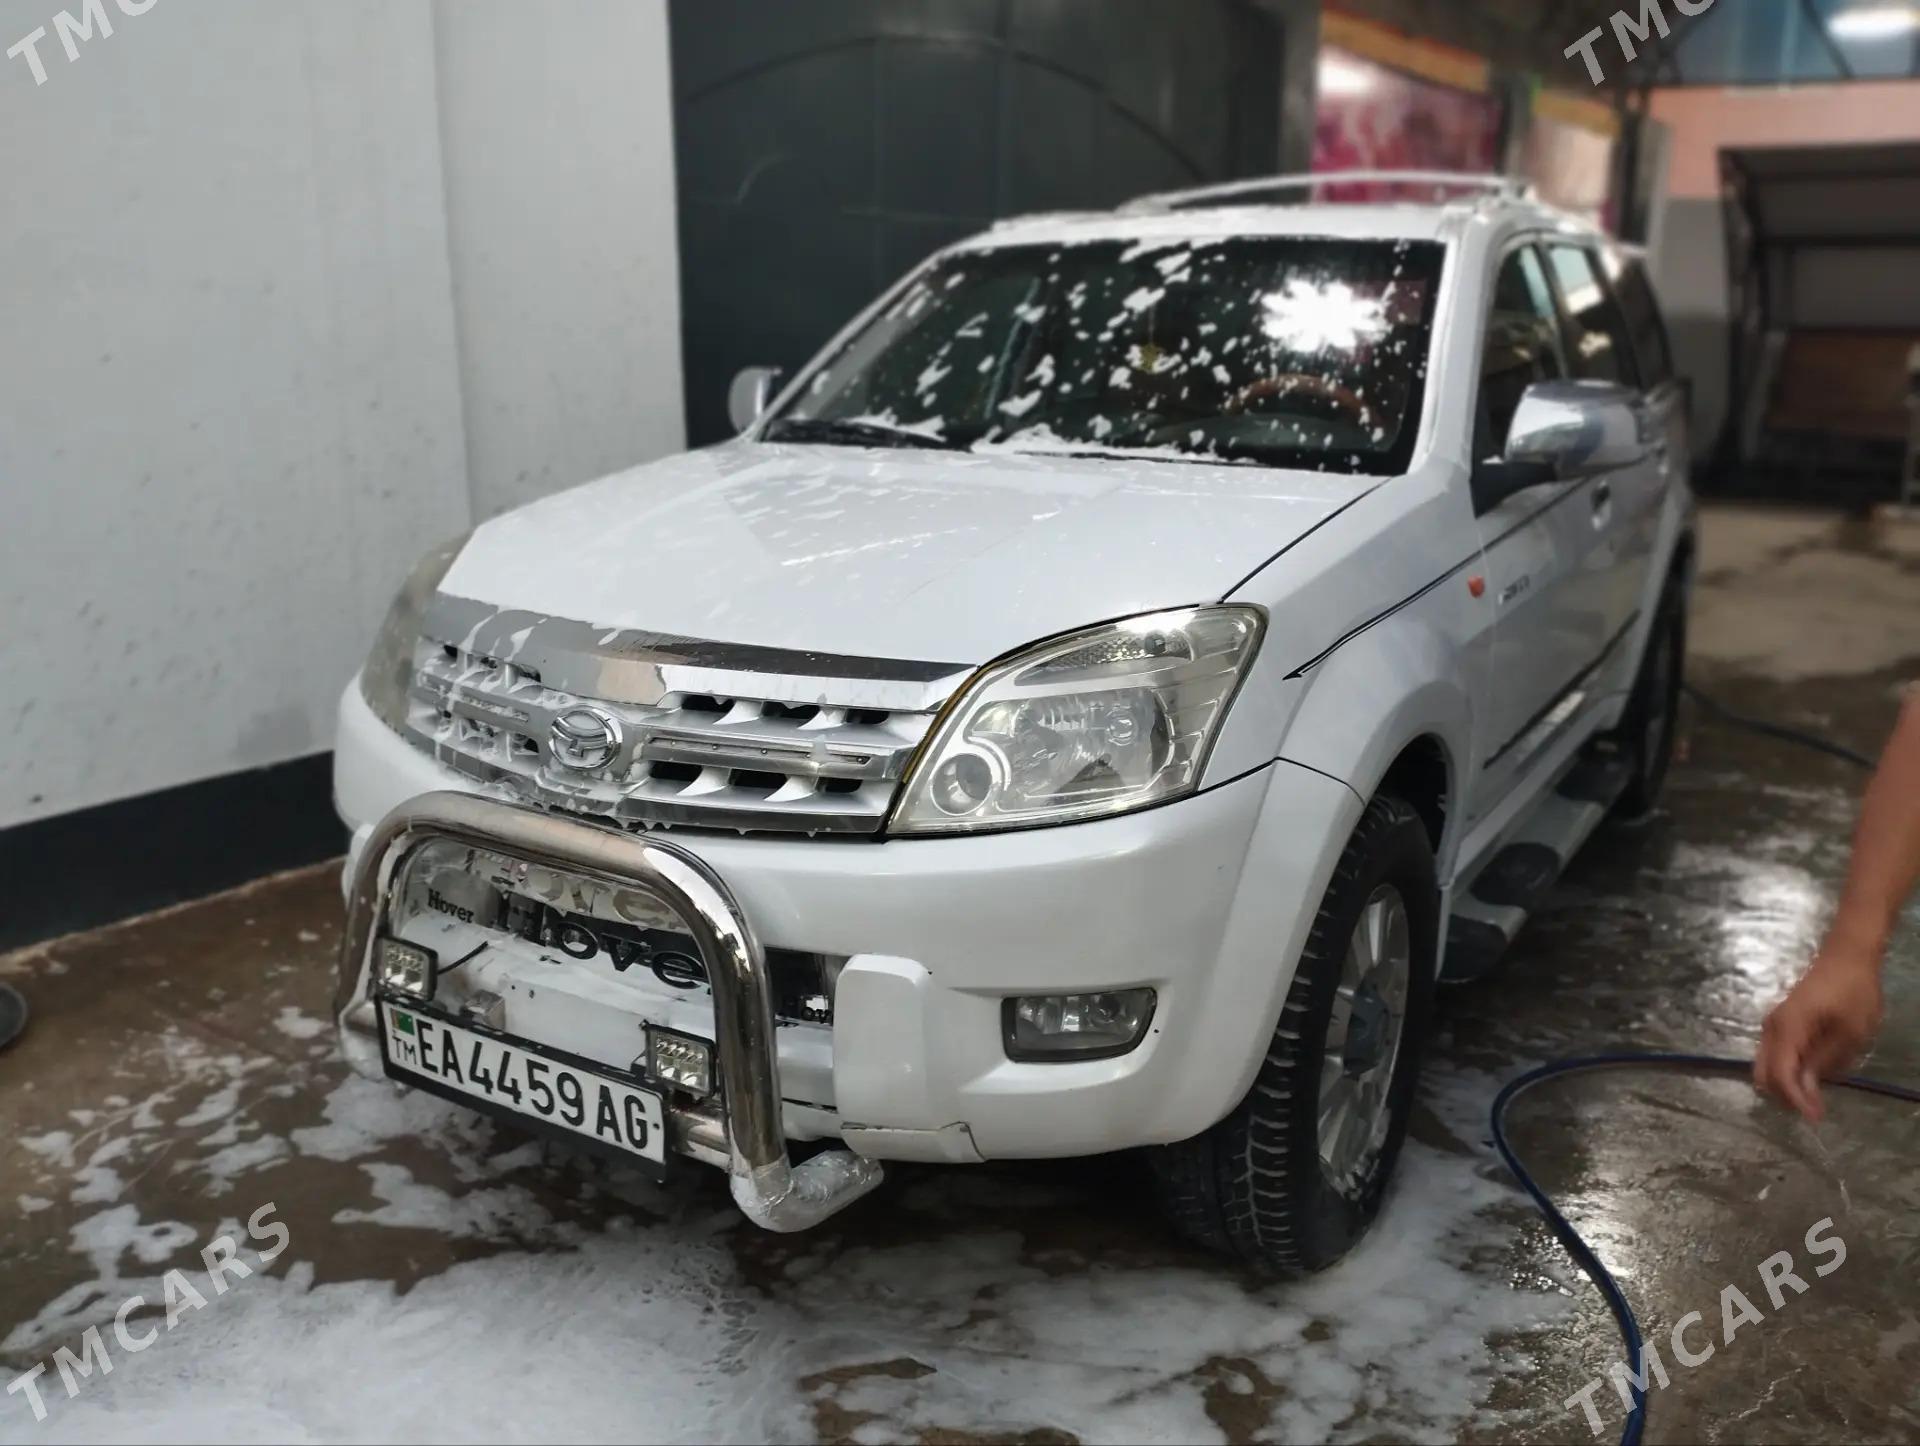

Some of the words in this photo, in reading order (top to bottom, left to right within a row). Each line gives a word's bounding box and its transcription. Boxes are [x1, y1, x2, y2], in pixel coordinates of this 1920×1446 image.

[427, 887, 475, 924] Hover
[499, 889, 713, 990] Hove
[391, 1034, 417, 1065] TM
